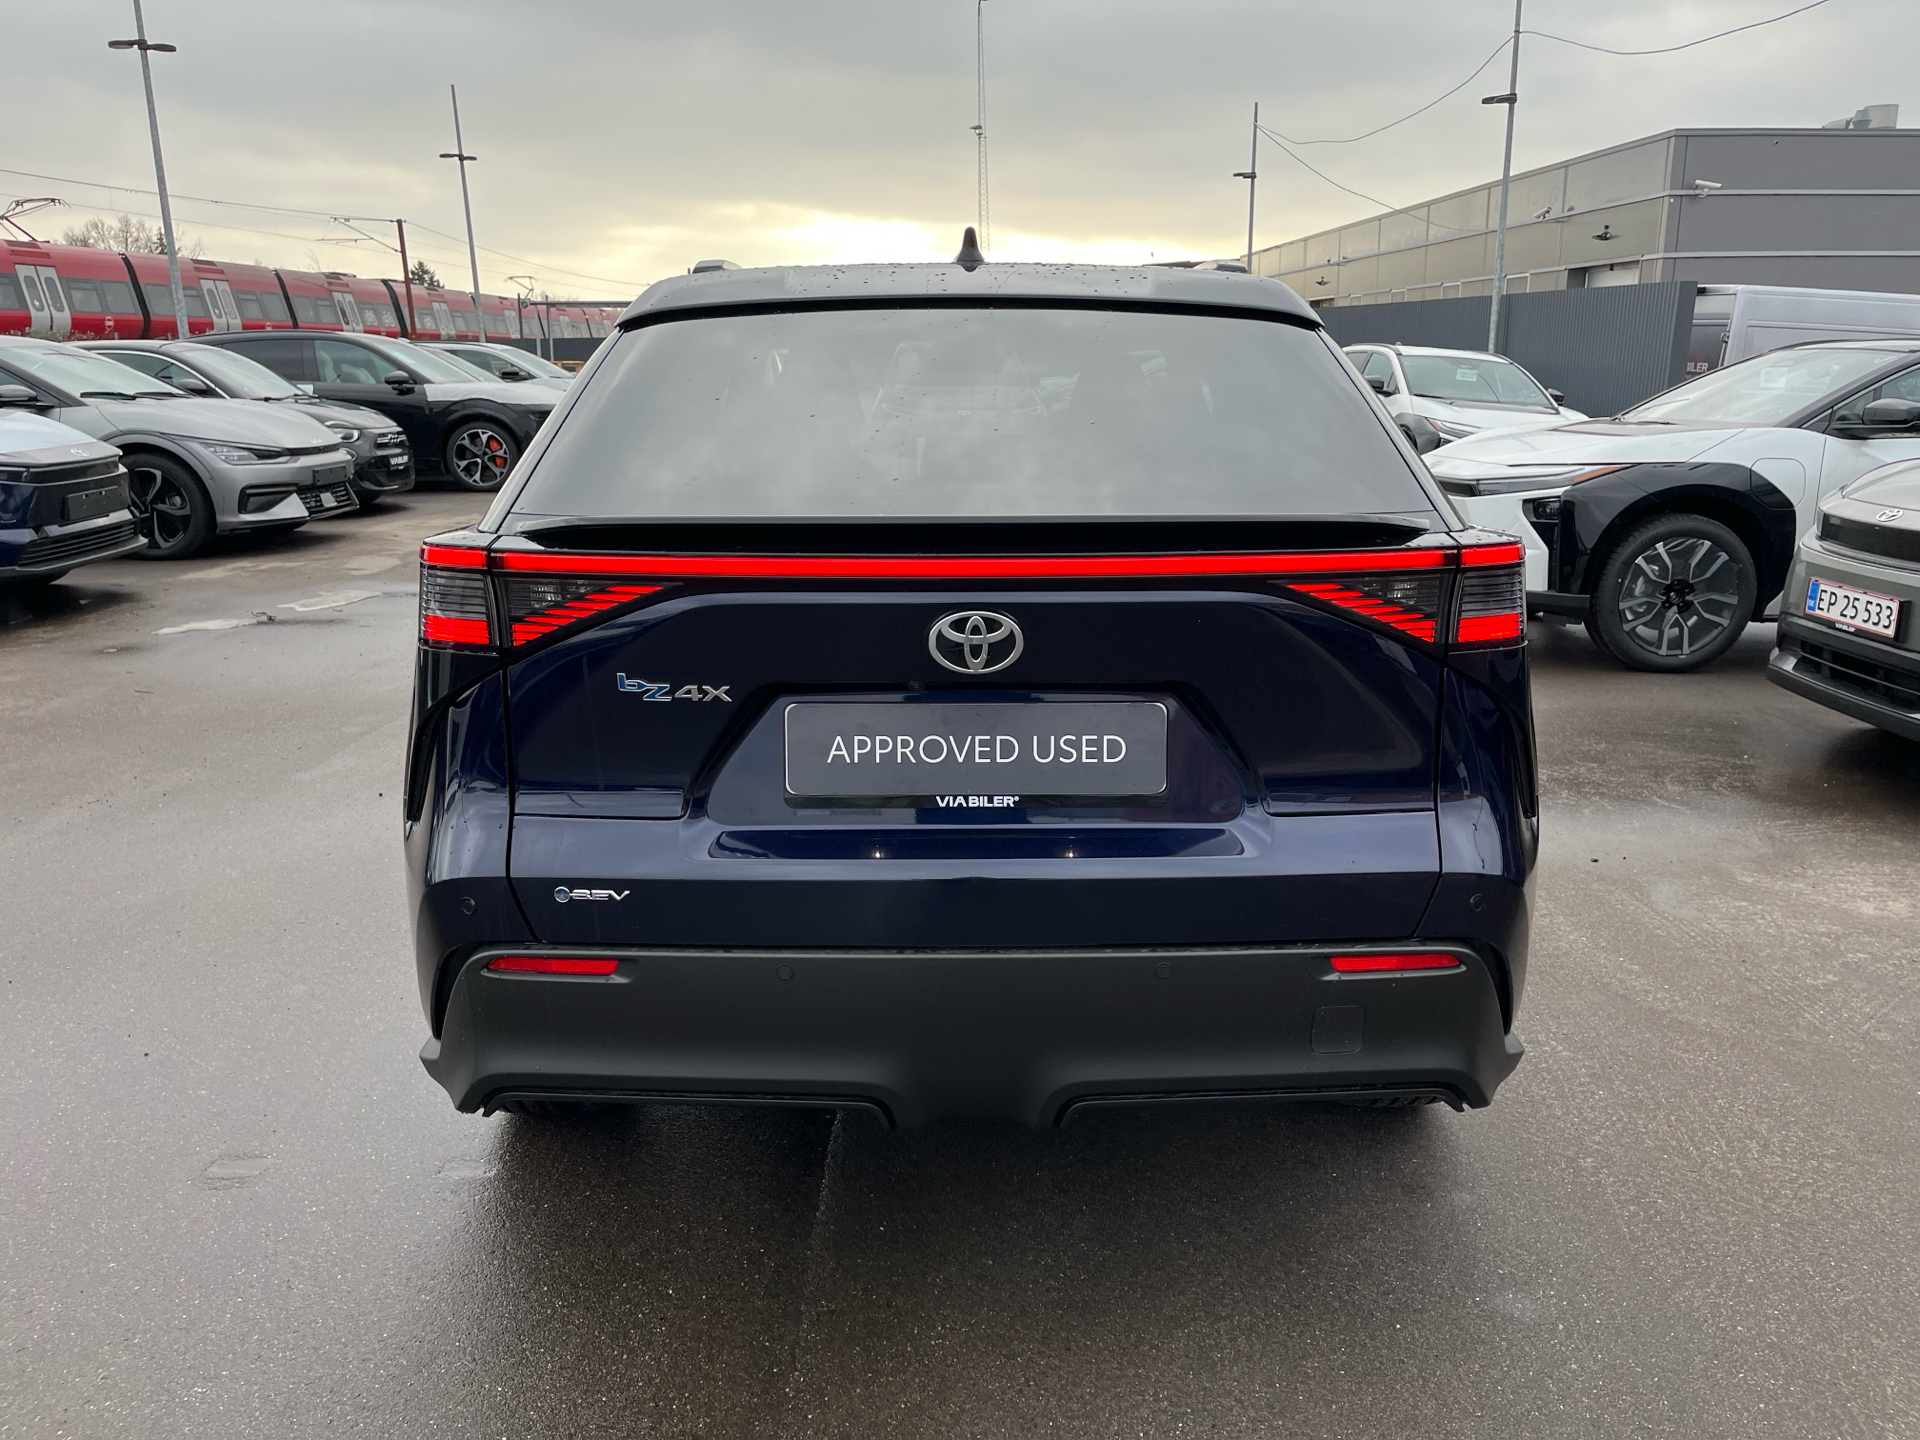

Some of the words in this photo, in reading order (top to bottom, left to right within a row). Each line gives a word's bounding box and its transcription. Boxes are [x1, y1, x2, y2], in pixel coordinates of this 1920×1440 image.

[1817, 589, 1838, 613] EP
[1840, 594, 1861, 620] 25
[1862, 600, 1894, 630] 533
[826, 734, 1020, 765] APPROVED
[1032, 734, 1128, 765] USED
